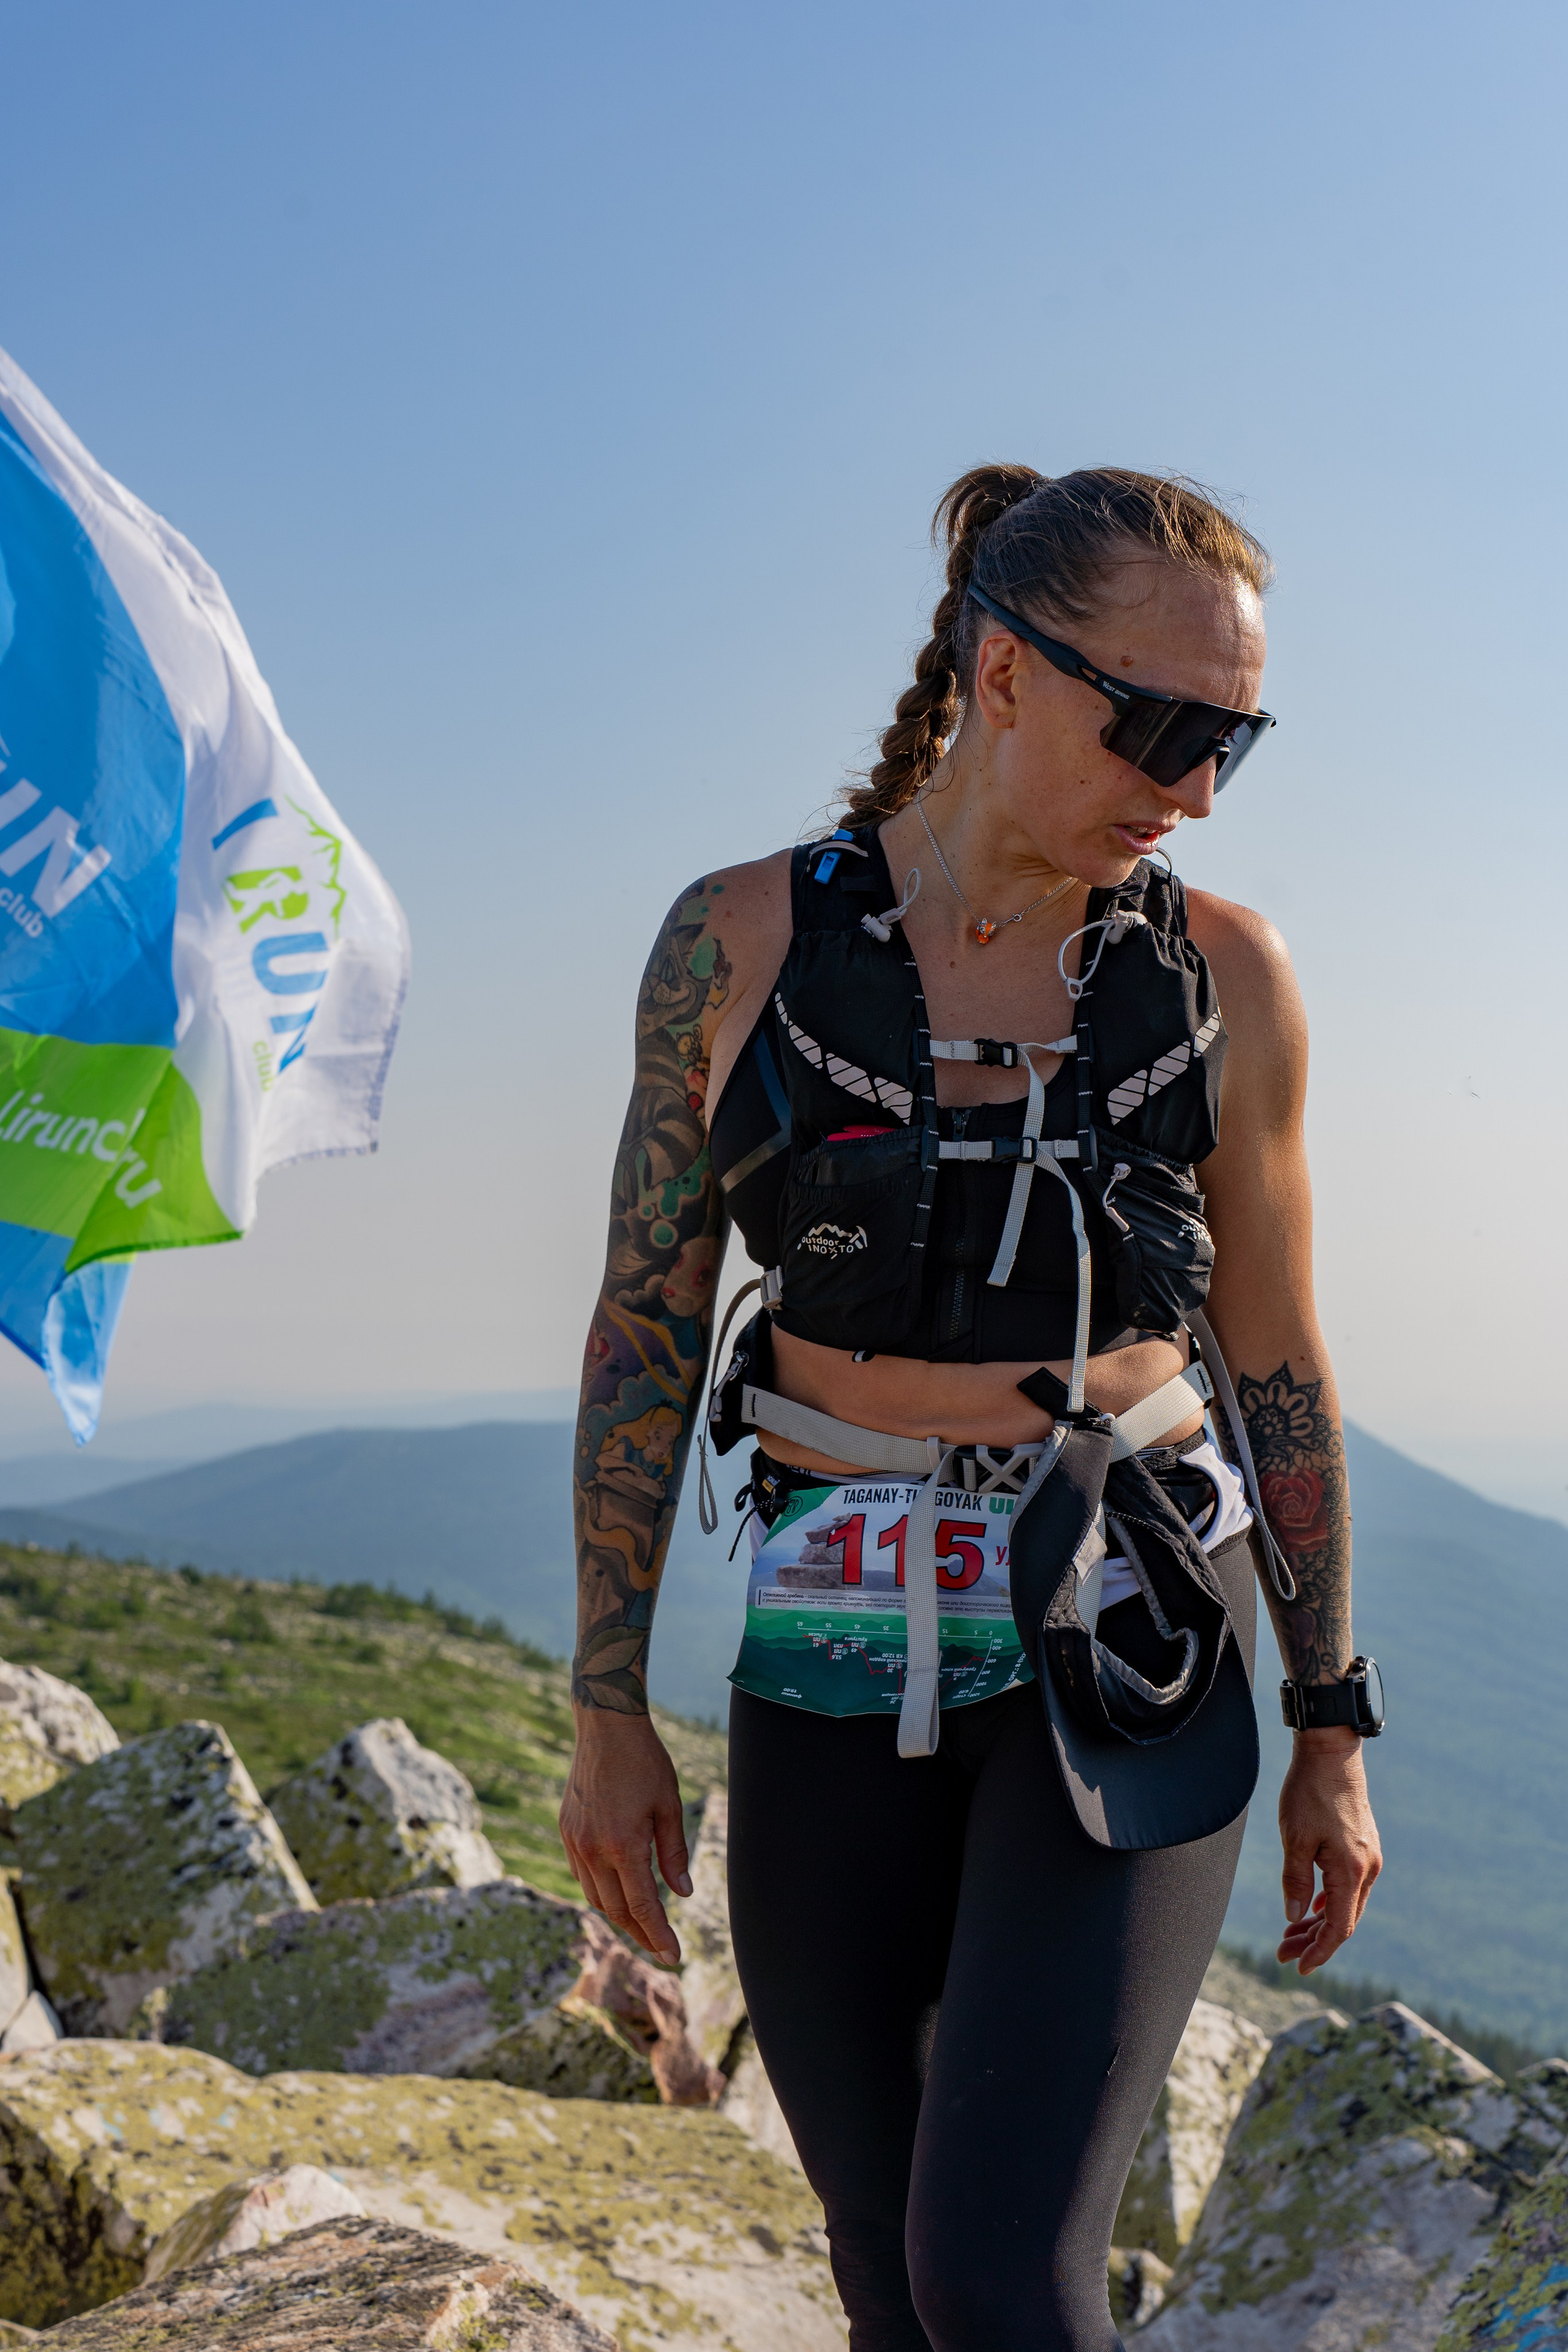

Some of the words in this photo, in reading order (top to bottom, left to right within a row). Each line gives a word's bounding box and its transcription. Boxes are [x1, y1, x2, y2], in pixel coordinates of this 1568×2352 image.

[1103, 680, 1115, 692] WEST
[1115, 690, 1130, 699] BIKING
[802, 1236, 839, 1246] outdoor
[826, 1513, 987, 1591] 115
